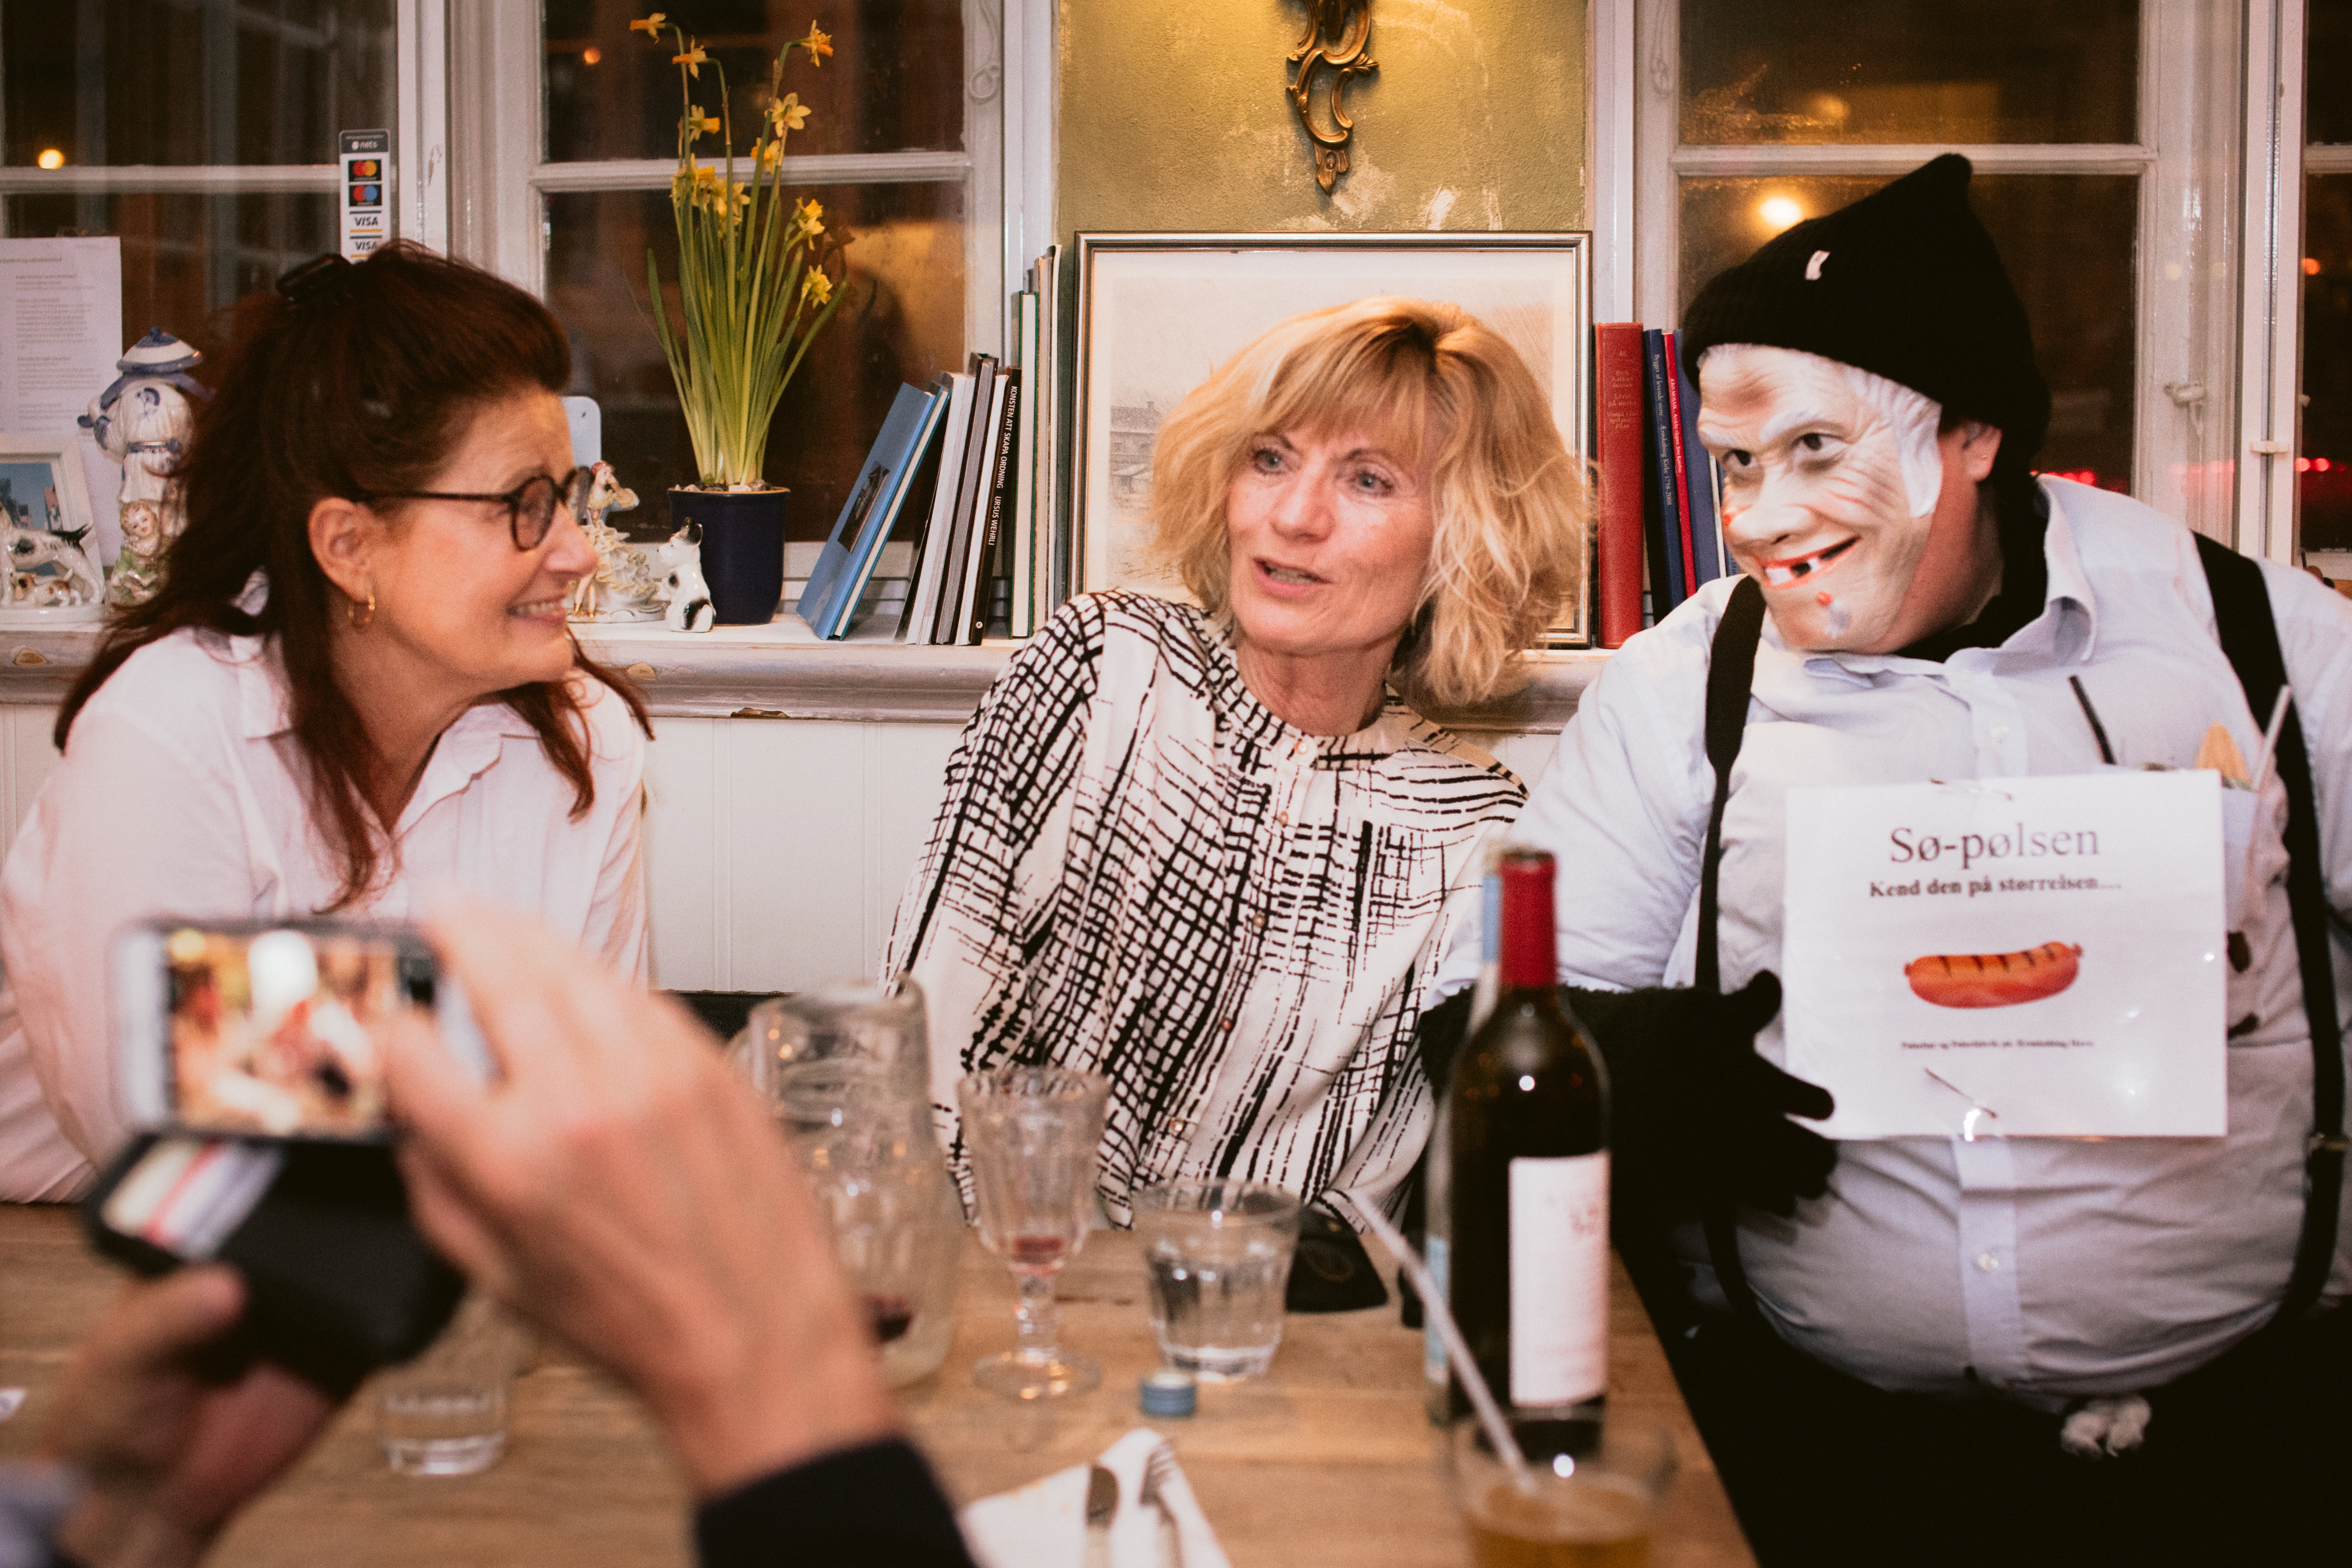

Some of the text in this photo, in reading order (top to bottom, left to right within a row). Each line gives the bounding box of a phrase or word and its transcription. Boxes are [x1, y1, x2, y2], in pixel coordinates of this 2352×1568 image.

[354, 217, 378, 226] VISA
[355, 242, 377, 250] VISA
[1007, 386, 1018, 417] KONSTEN
[1001, 432, 1011, 454] SKAPA
[997, 456, 1007, 489] ORDNING
[1664, 476, 1673, 506] 1758-2008
[992, 496, 1002, 518] URSUS
[988, 520, 998, 546] WEHRLI
[1891, 823, 2099, 869] Sø-pølsen
[1870, 880, 1920, 896] Kend
[1926, 878, 1961, 894] den
[1968, 875, 1992, 897] på
